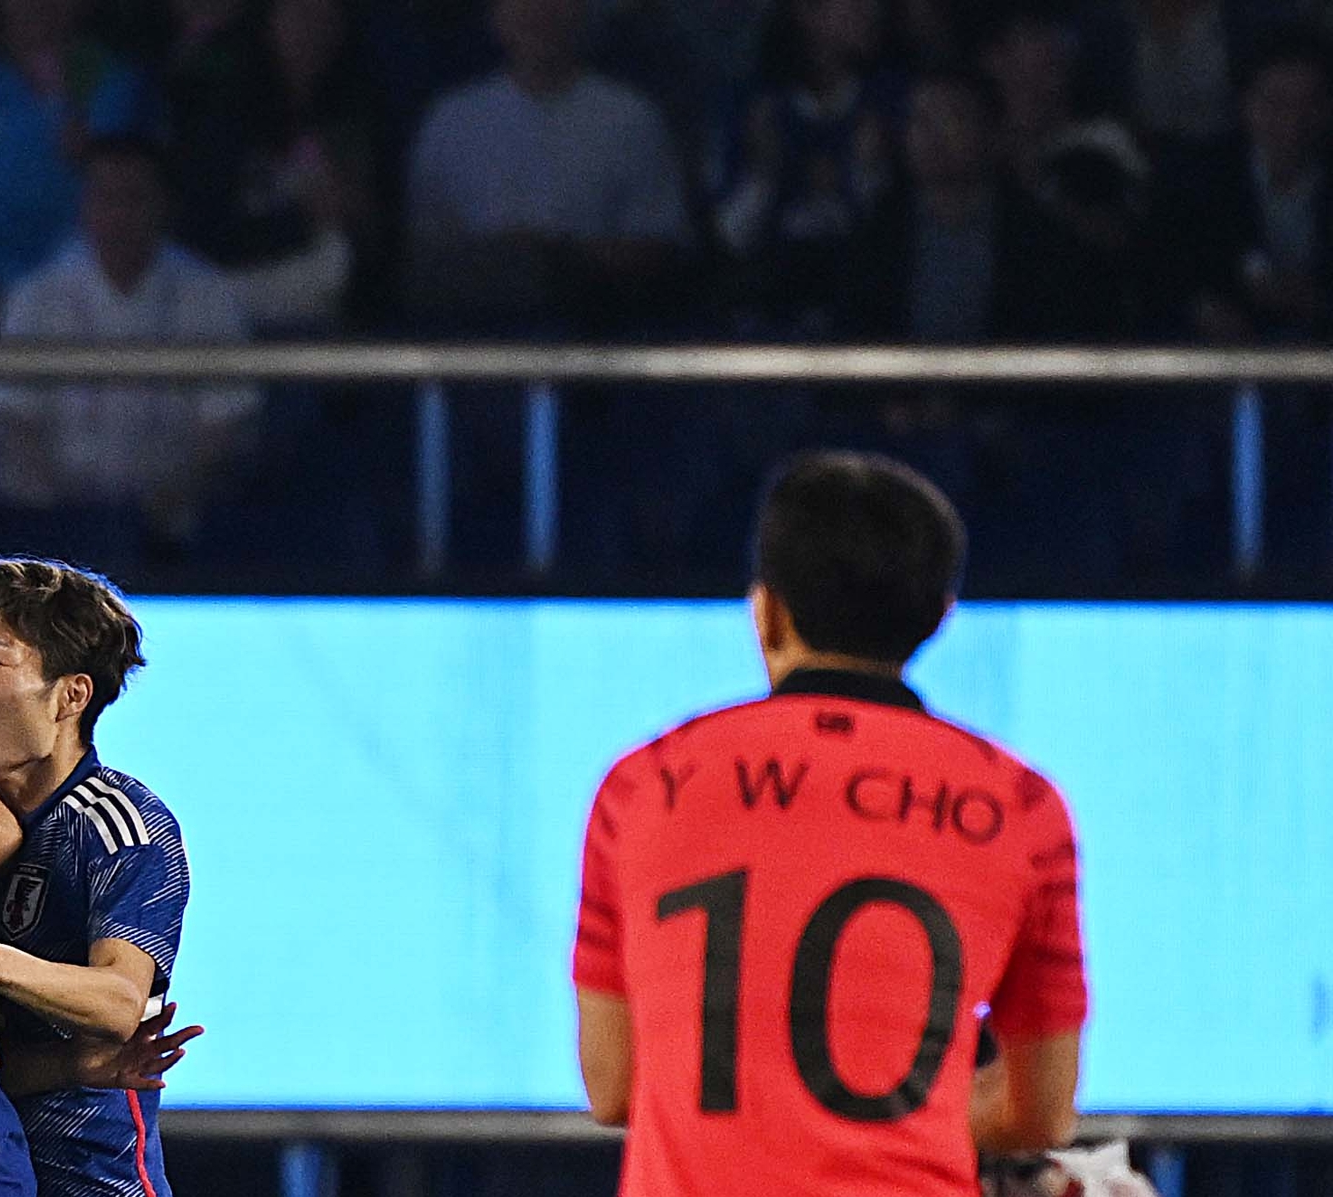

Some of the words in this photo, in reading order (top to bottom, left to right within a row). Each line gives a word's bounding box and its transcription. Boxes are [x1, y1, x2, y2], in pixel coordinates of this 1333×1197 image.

[660, 763, 696, 813] Y
[736, 757, 807, 809] W
[846, 767, 1005, 843] CHO
[657, 865, 965, 1123] 10
